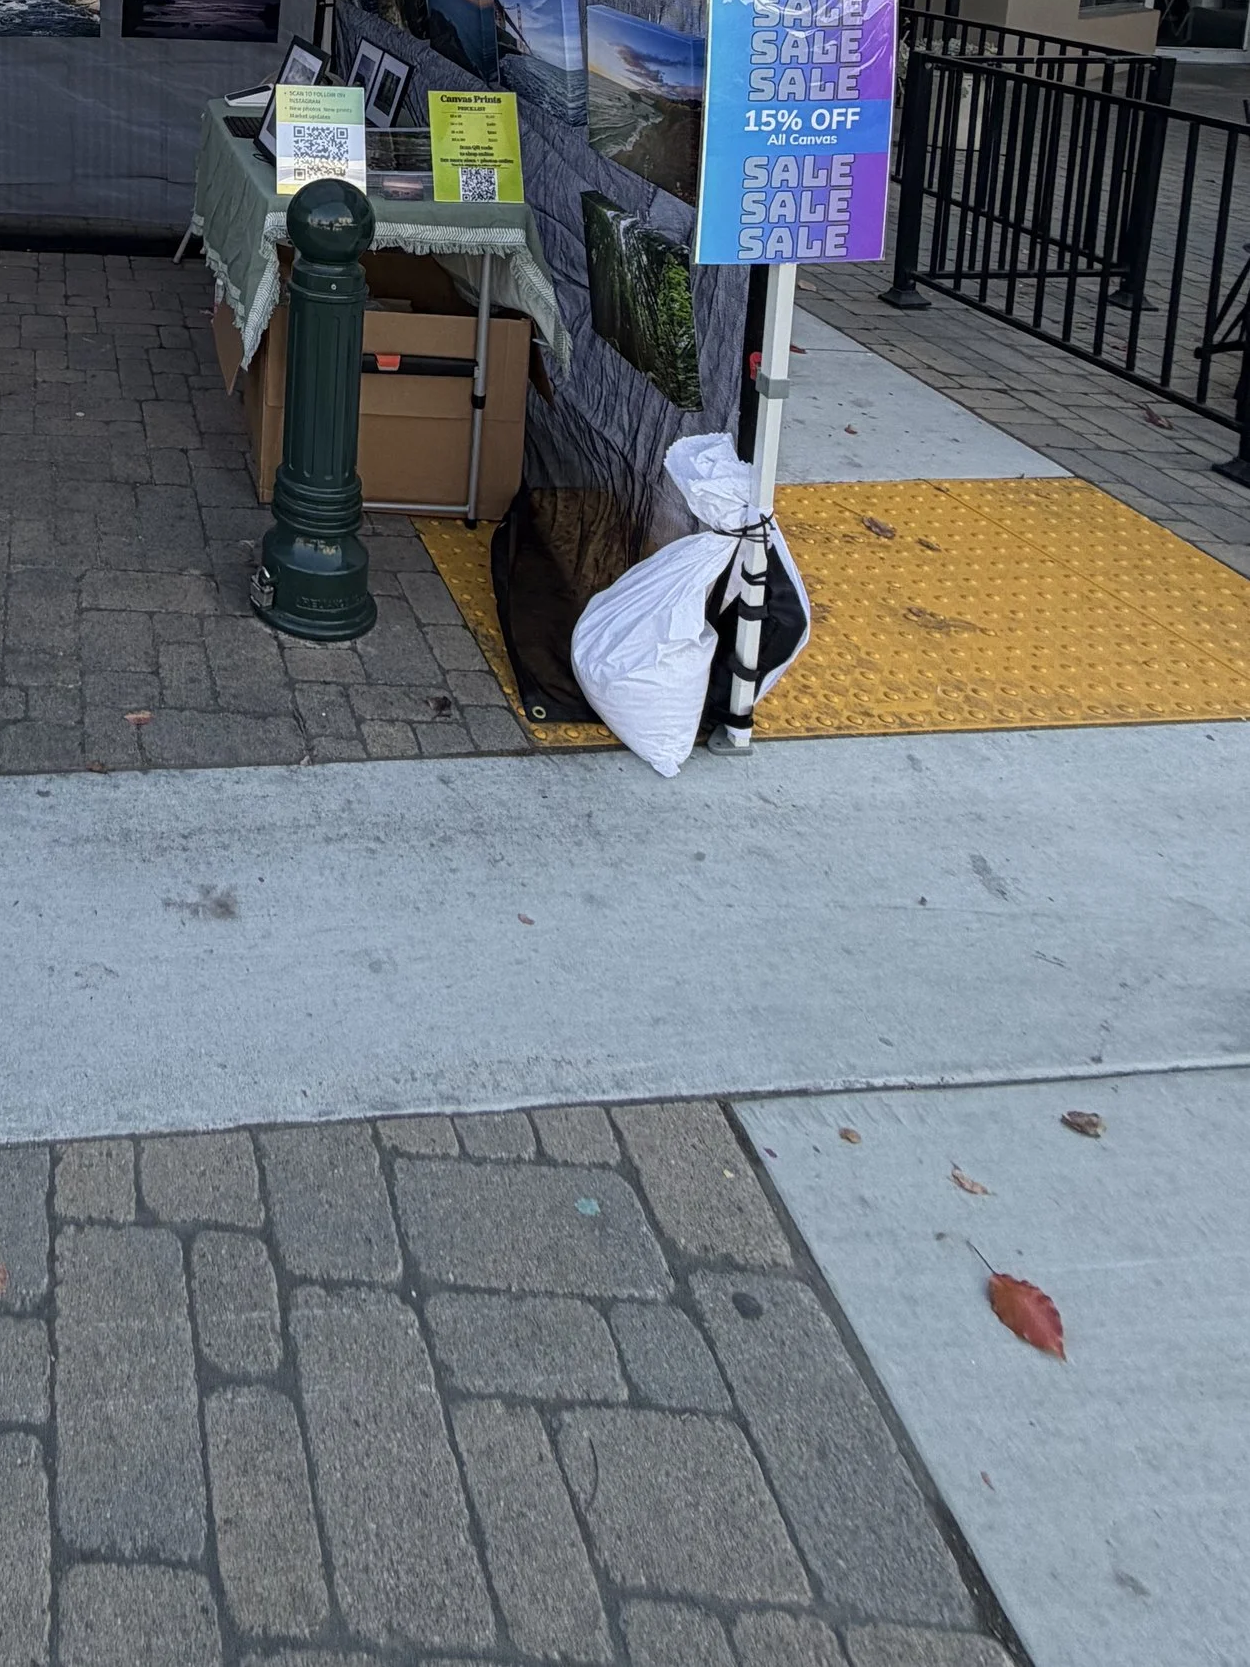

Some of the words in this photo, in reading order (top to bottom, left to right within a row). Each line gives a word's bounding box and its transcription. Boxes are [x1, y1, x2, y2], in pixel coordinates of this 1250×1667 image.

[750, 28, 864, 65] SALE
[440, 94, 472, 103] Canvas
[474, 95, 501, 104] Prints
[748, 66, 861, 102] SALE
[744, 109, 803, 132] 15%
[811, 108, 860, 131] OFF
[767, 134, 786, 145] All
[790, 134, 837, 145] Canvas
[743, 153, 855, 189] SALE
[740, 189, 852, 225] SALE
[737, 224, 850, 260] SALE
